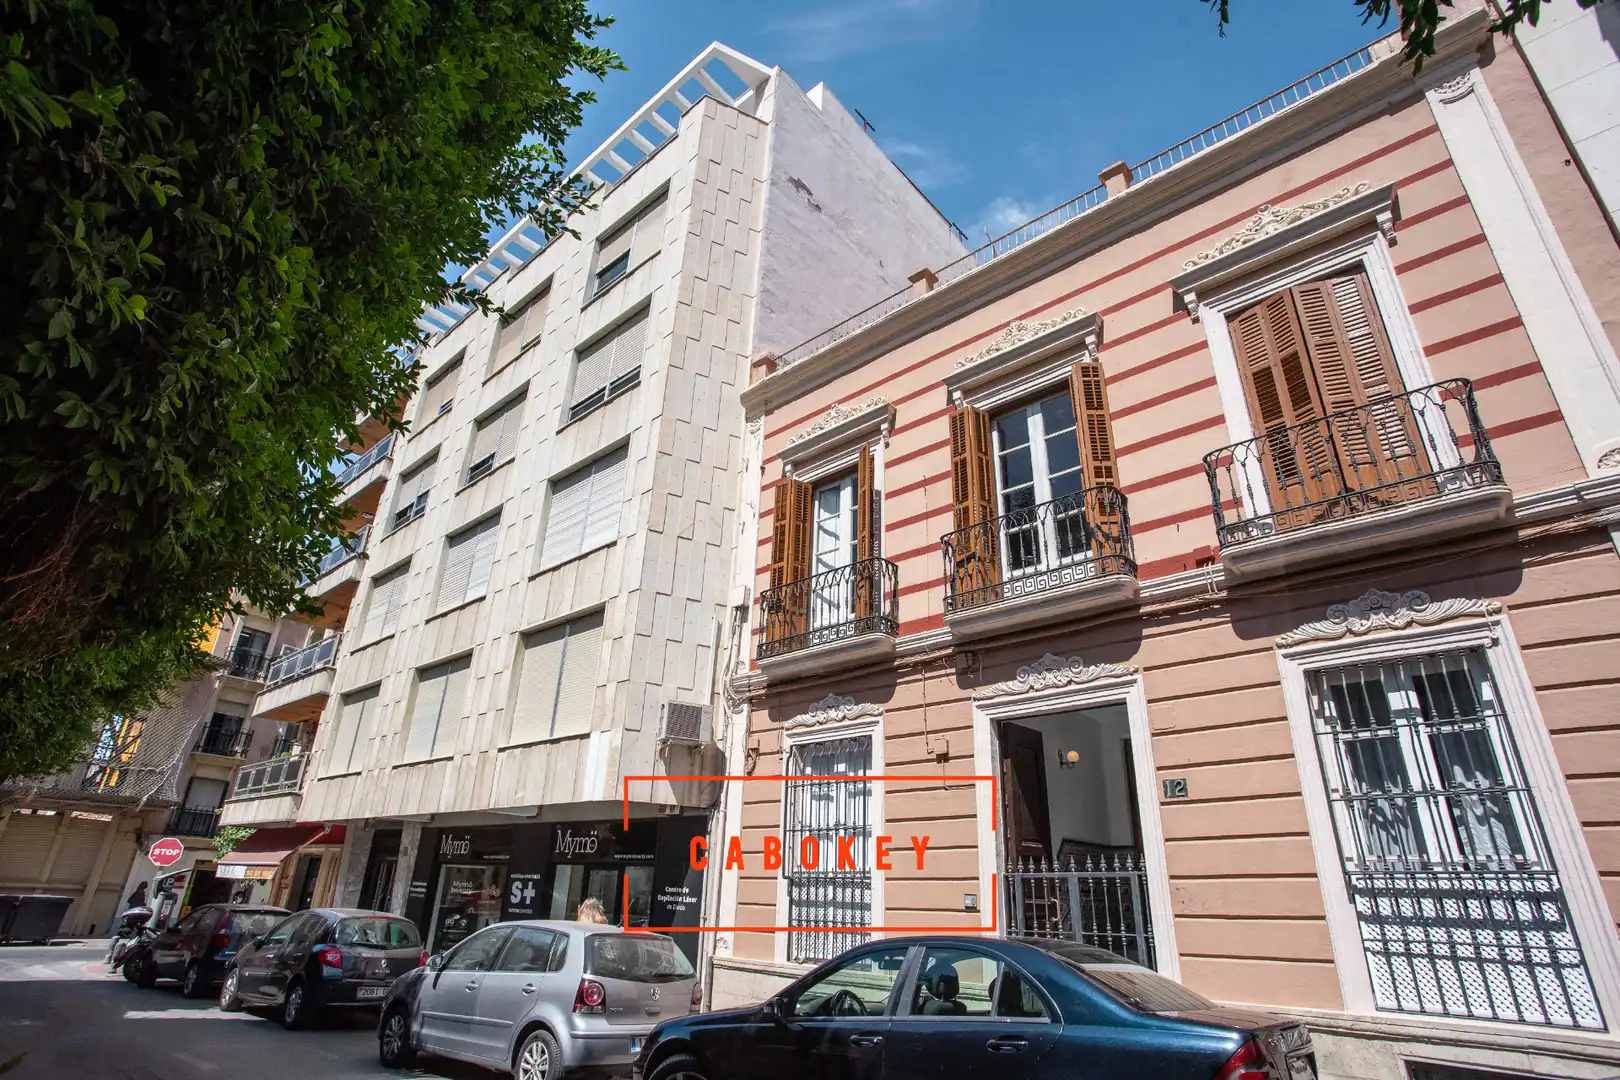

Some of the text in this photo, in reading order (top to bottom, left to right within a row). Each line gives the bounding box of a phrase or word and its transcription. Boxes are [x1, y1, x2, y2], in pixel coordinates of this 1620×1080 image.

[1165, 779, 1186, 798] 12
[153, 848, 180, 856] STOP
[682, 886, 690, 894] de
